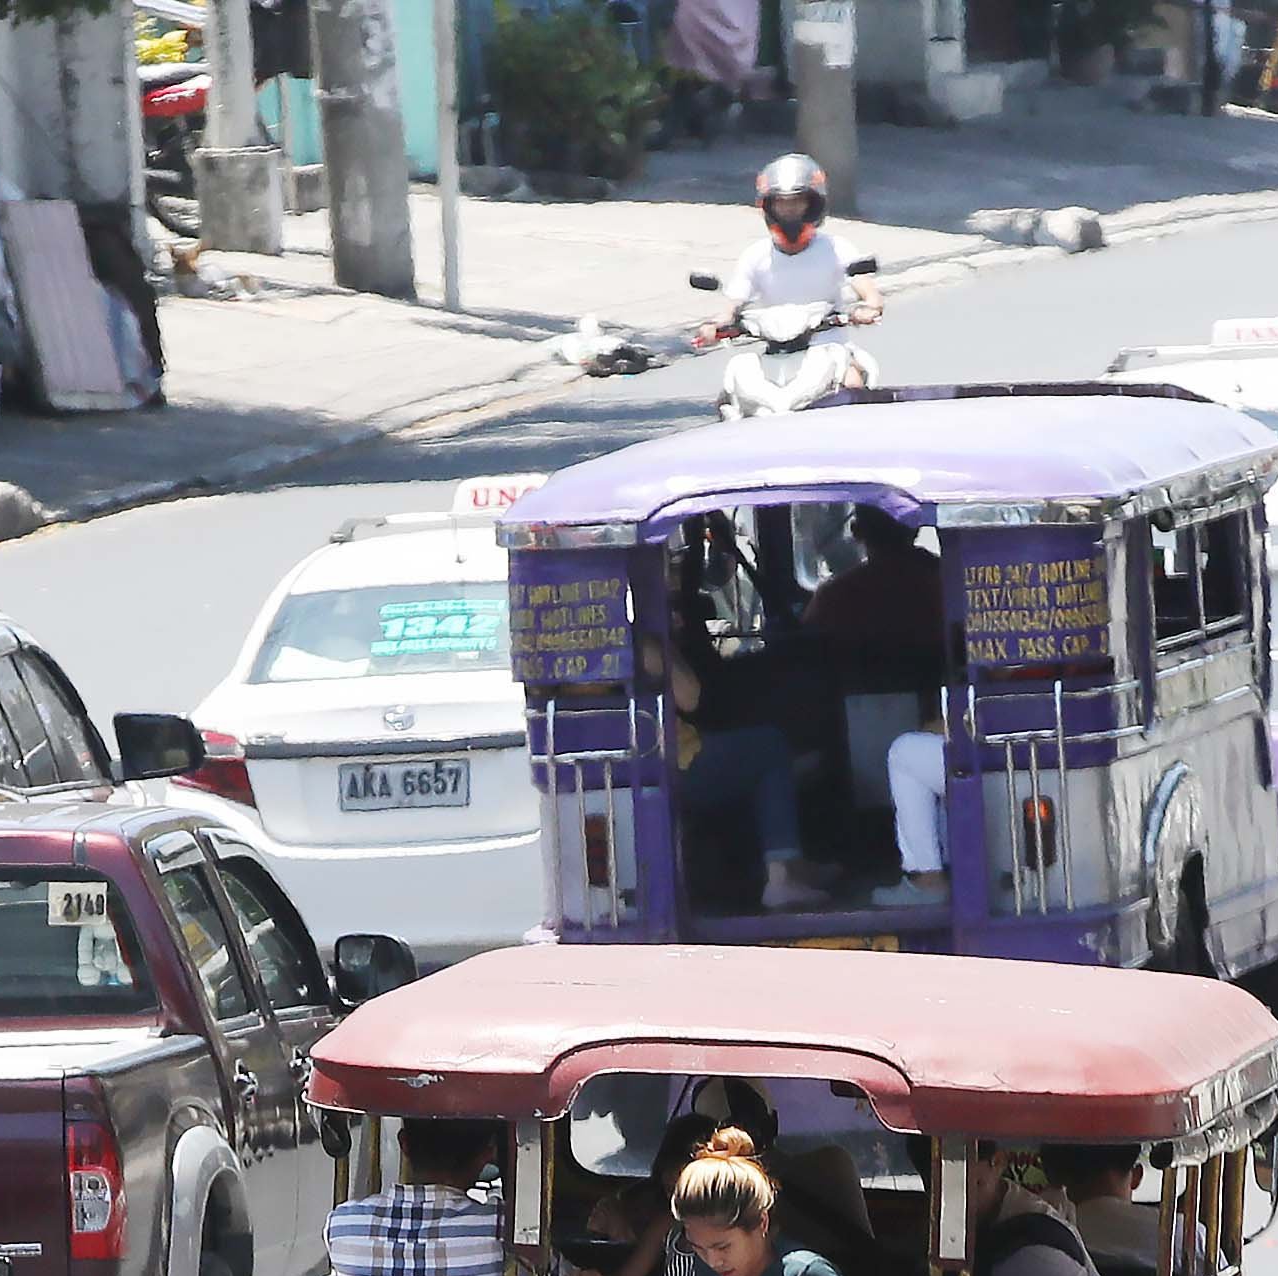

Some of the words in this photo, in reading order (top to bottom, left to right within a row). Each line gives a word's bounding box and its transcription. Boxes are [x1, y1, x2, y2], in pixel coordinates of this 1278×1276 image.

[472, 486, 535, 507] UN
[346, 768, 393, 799] AKA
[402, 764, 462, 796] 6657
